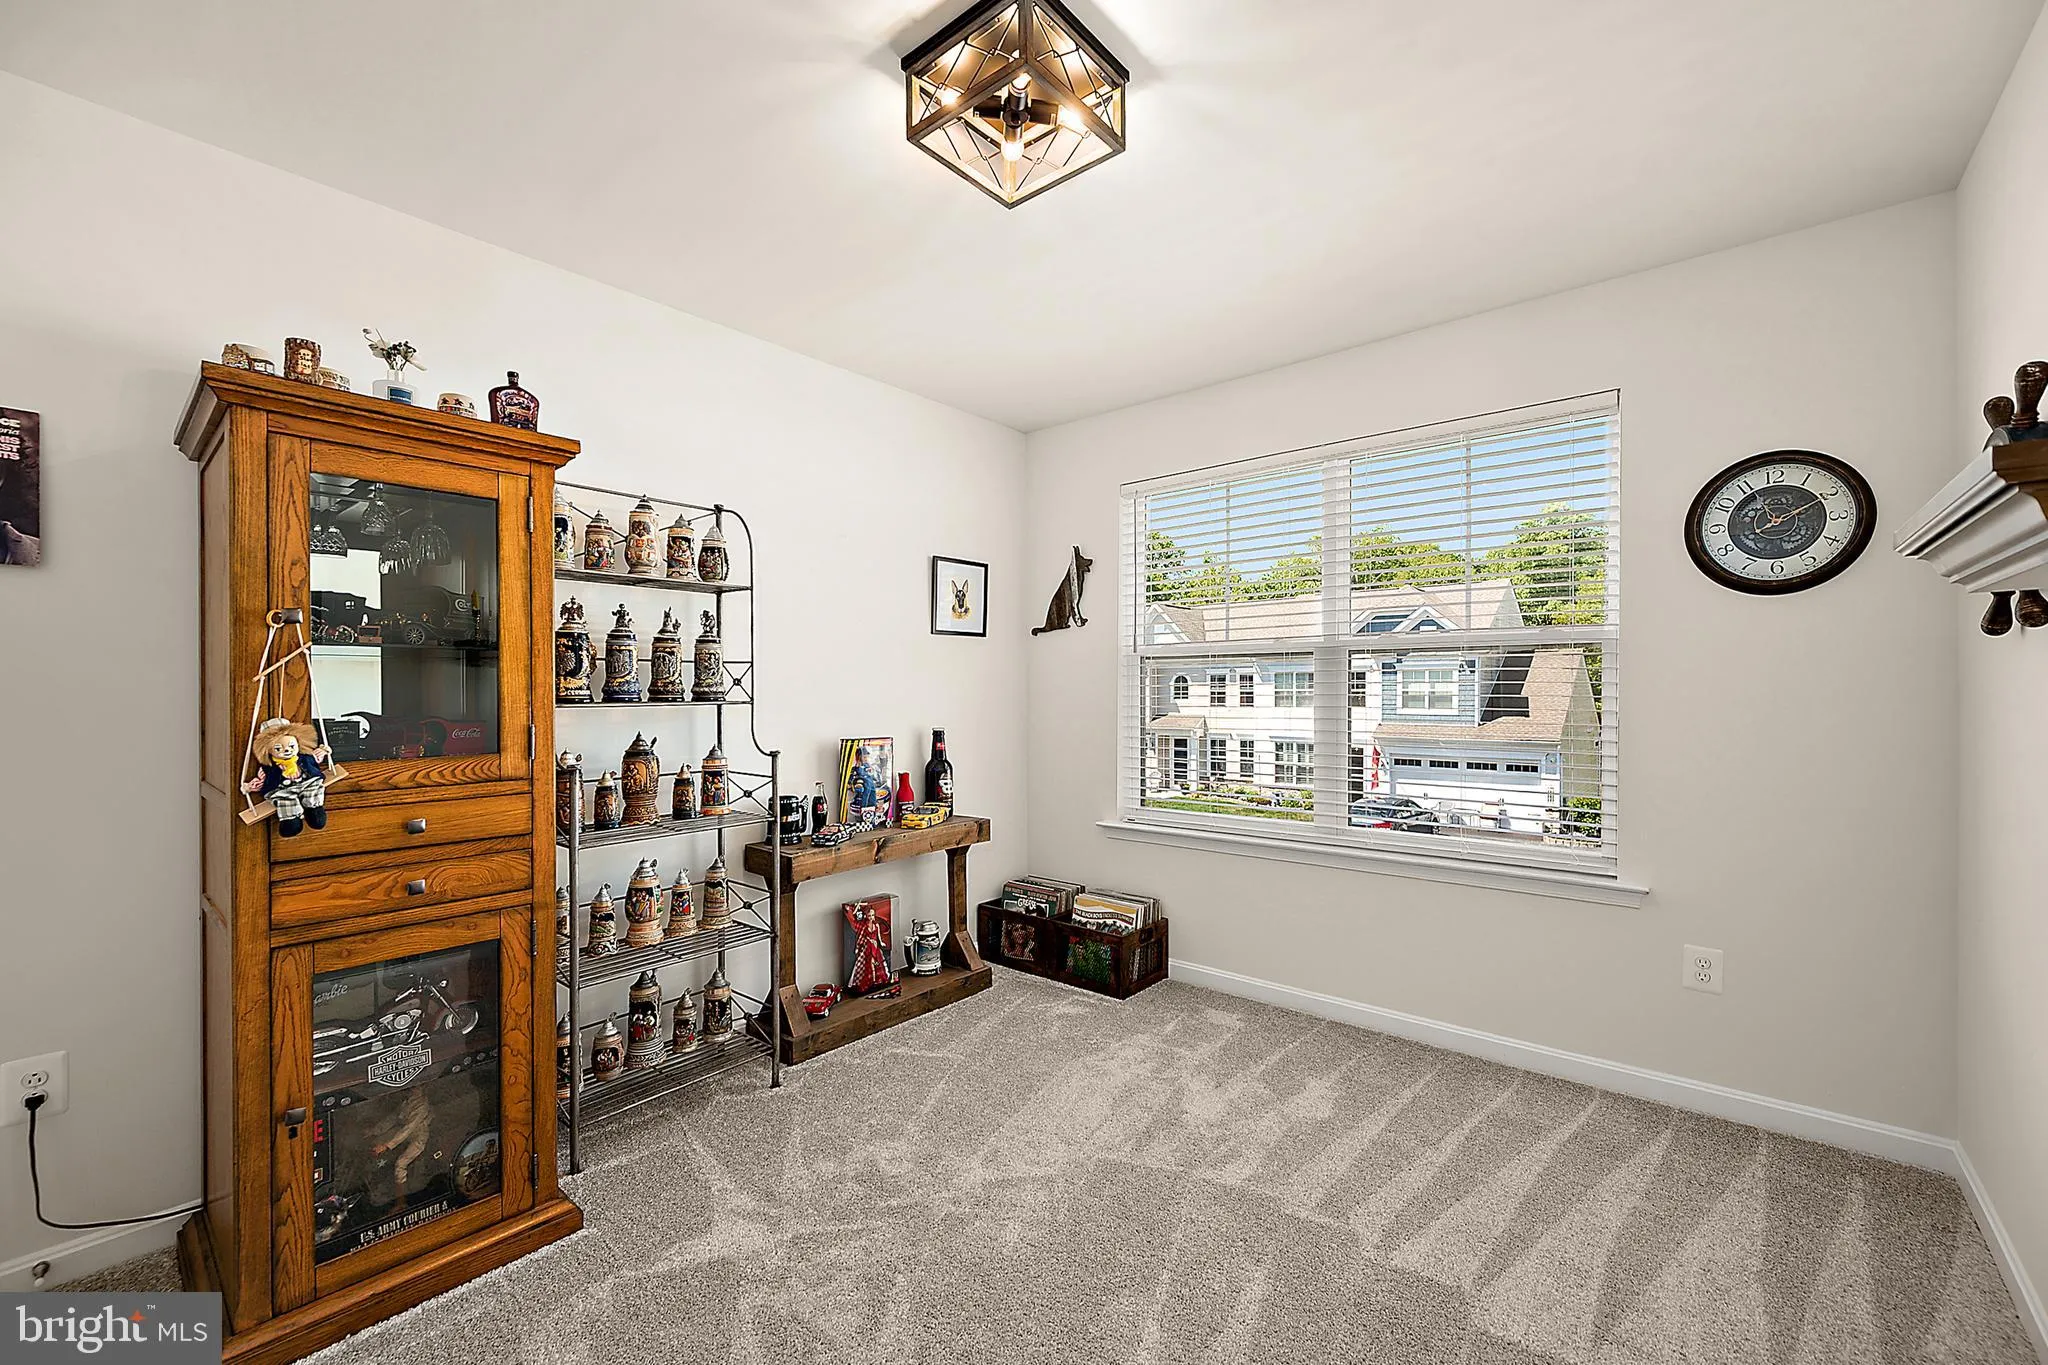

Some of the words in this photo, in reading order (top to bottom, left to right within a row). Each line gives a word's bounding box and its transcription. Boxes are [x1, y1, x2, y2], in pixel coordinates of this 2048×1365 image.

[1765, 469, 1785, 485] 12
[1800, 473, 1812, 486] 1
[1736, 480, 1754, 495] 11
[1819, 486, 1839, 501] 2
[1715, 497, 1735, 514] 10
[1828, 509, 1848, 522] 3
[1709, 523, 1726, 535] 9
[1823, 534, 1840, 548] 4
[1717, 543, 1735, 557] 8
[1740, 557, 1758, 571] 7
[1799, 551, 1817, 567] 5
[1770, 560, 1784, 575] 6
[313, 983, 348, 1004] arbie
[386, 1050, 415, 1063] MOTOR
[374, 1054, 426, 1076] HARLEY-DAVIDSON
[376, 1218, 401, 1237] ARMY
[403, 1203, 440, 1226] COURIER
